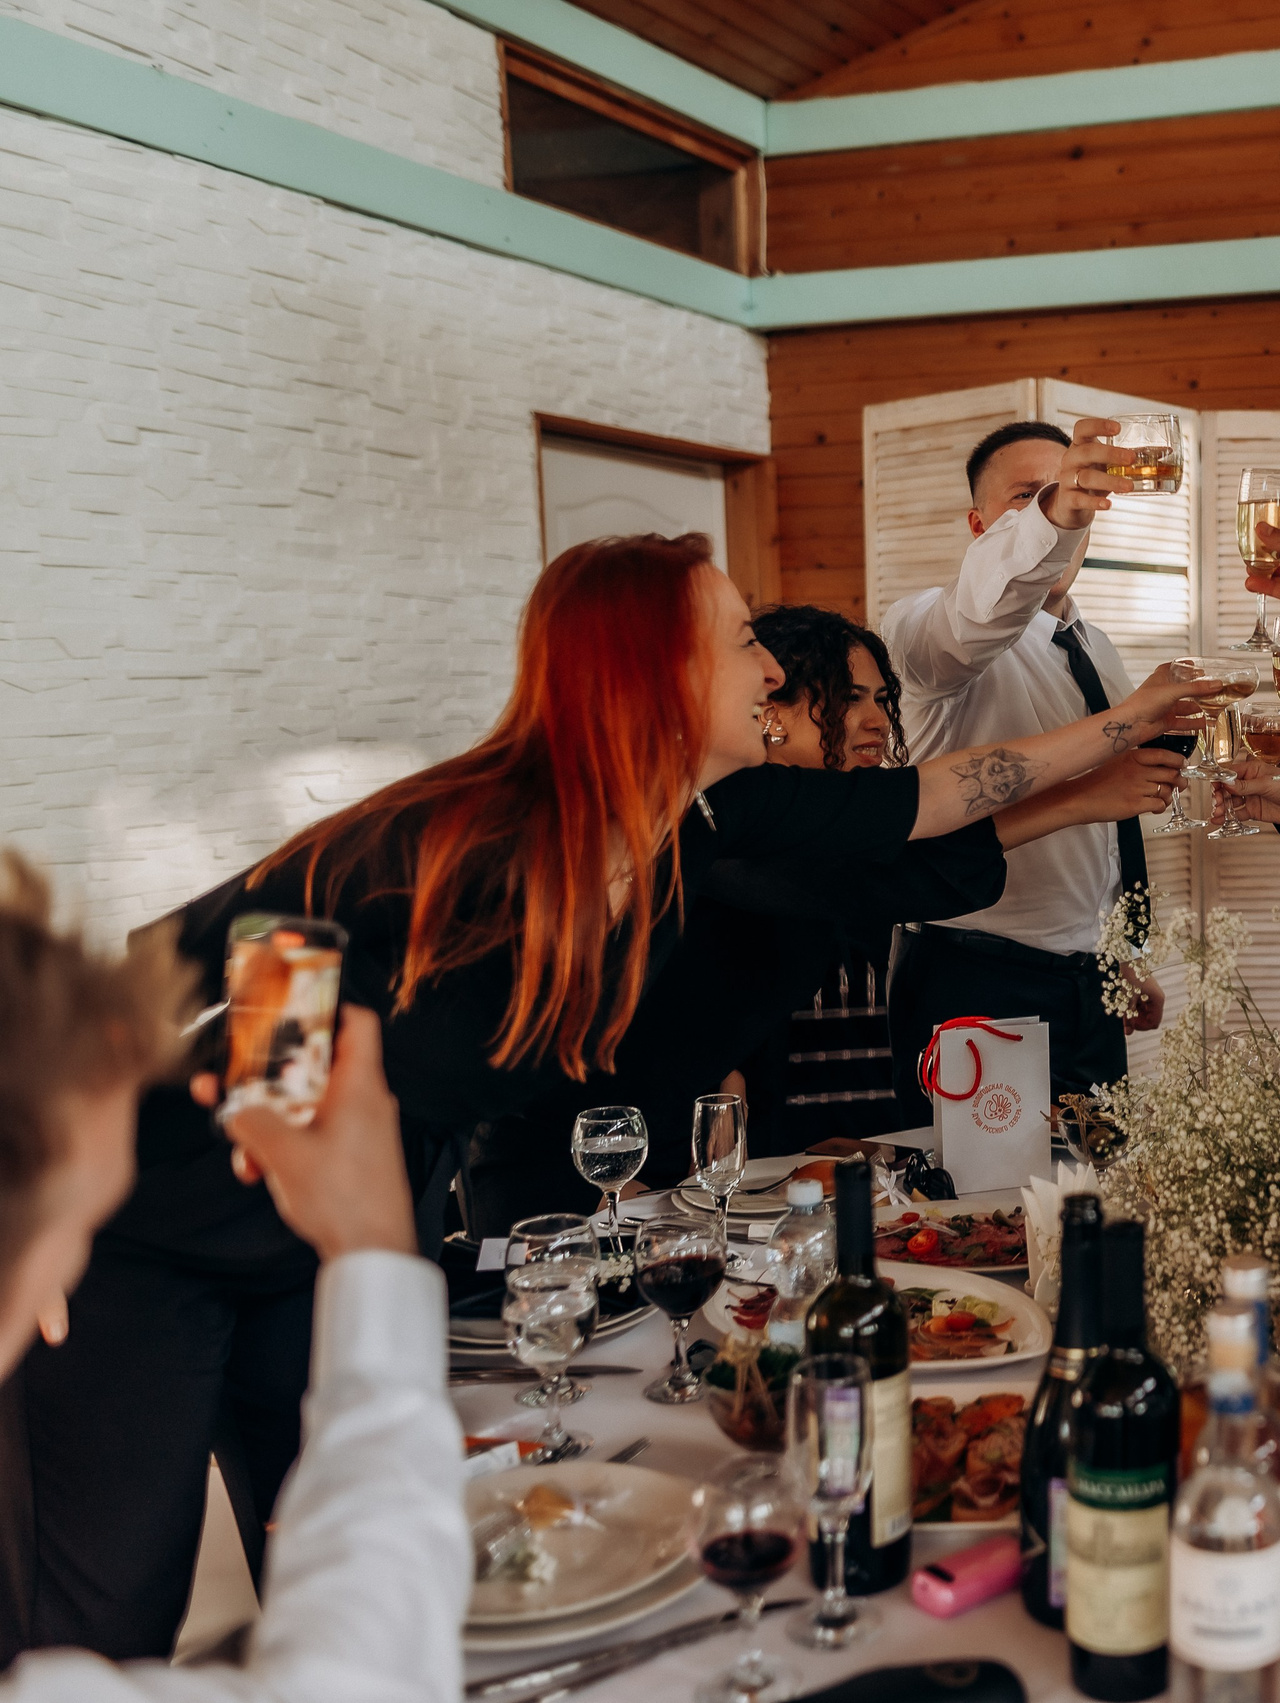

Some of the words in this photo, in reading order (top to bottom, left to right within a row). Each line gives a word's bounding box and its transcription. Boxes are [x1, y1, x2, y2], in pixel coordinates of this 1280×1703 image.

[1004, 1084, 1022, 1104] ОБЛАСТЬ
[971, 1112, 984, 1128] ДУША
[982, 1124, 1009, 1134] РУССКОГО
[1008, 1108, 1023, 1128] СЕВЕРА
